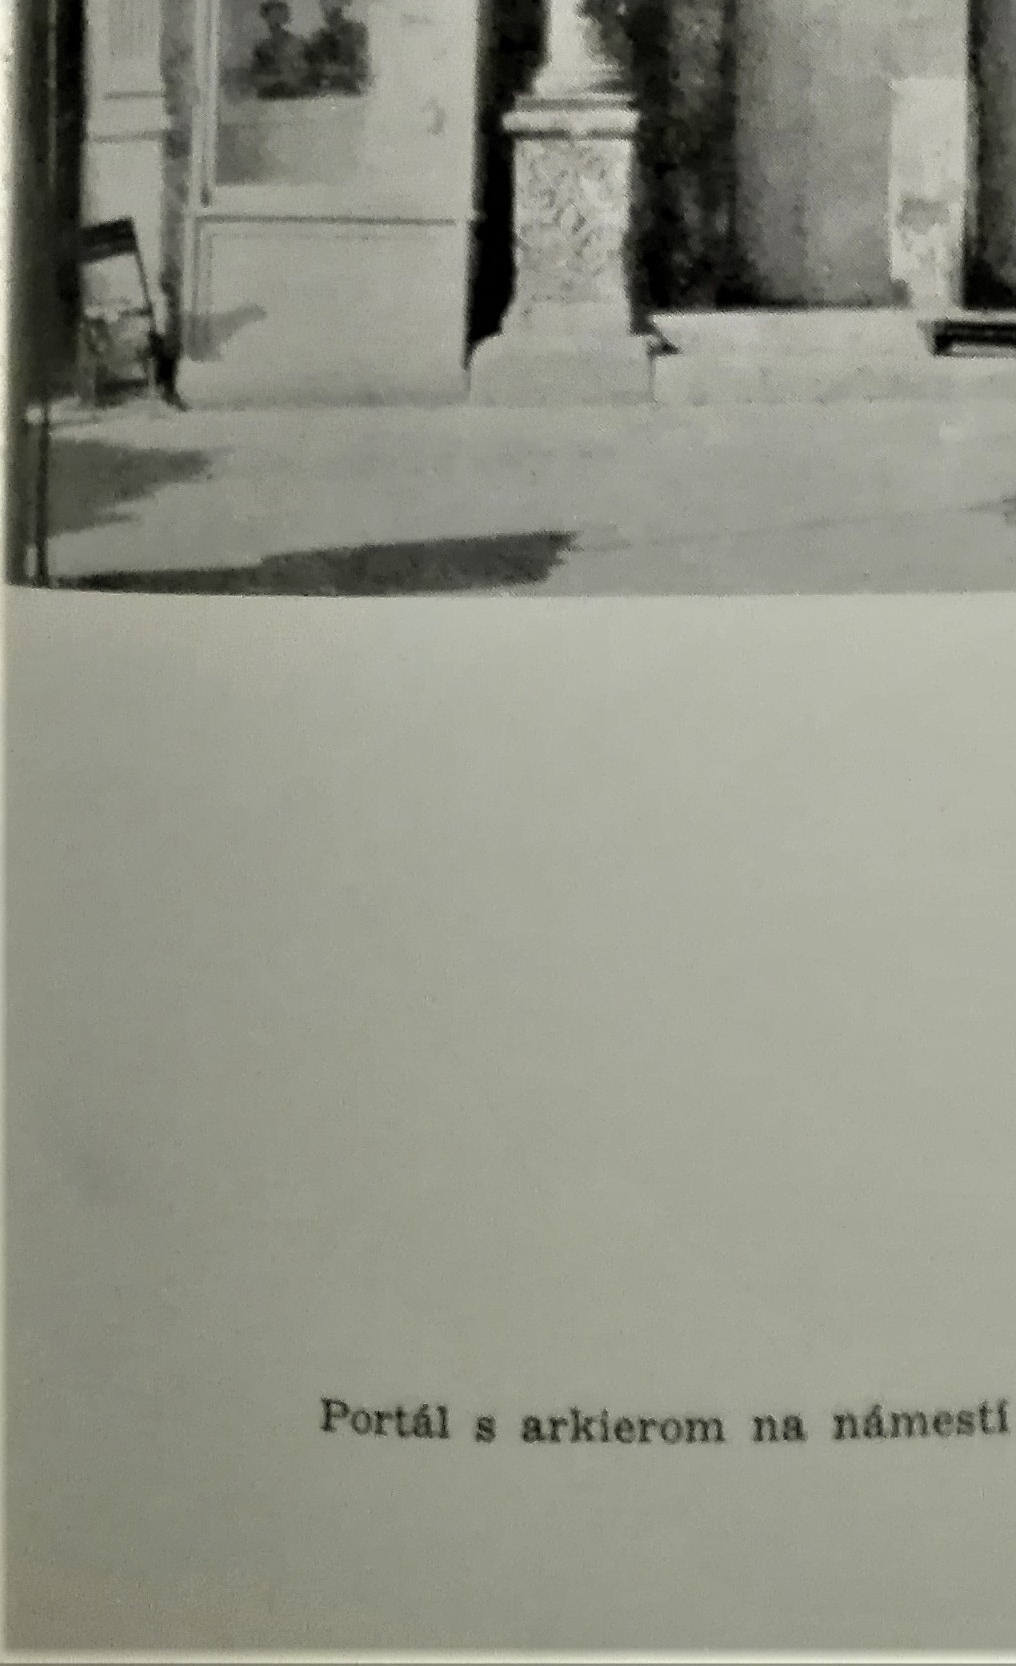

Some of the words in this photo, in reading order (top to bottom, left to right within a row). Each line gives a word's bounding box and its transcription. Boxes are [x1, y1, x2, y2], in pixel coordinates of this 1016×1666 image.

[320, 1396, 451, 1441] Portál
[474, 1414, 498, 1445] s
[520, 1407, 727, 1446] arkierom
[753, 1414, 808, 1444] na
[833, 1401, 1012, 1441] námestí
